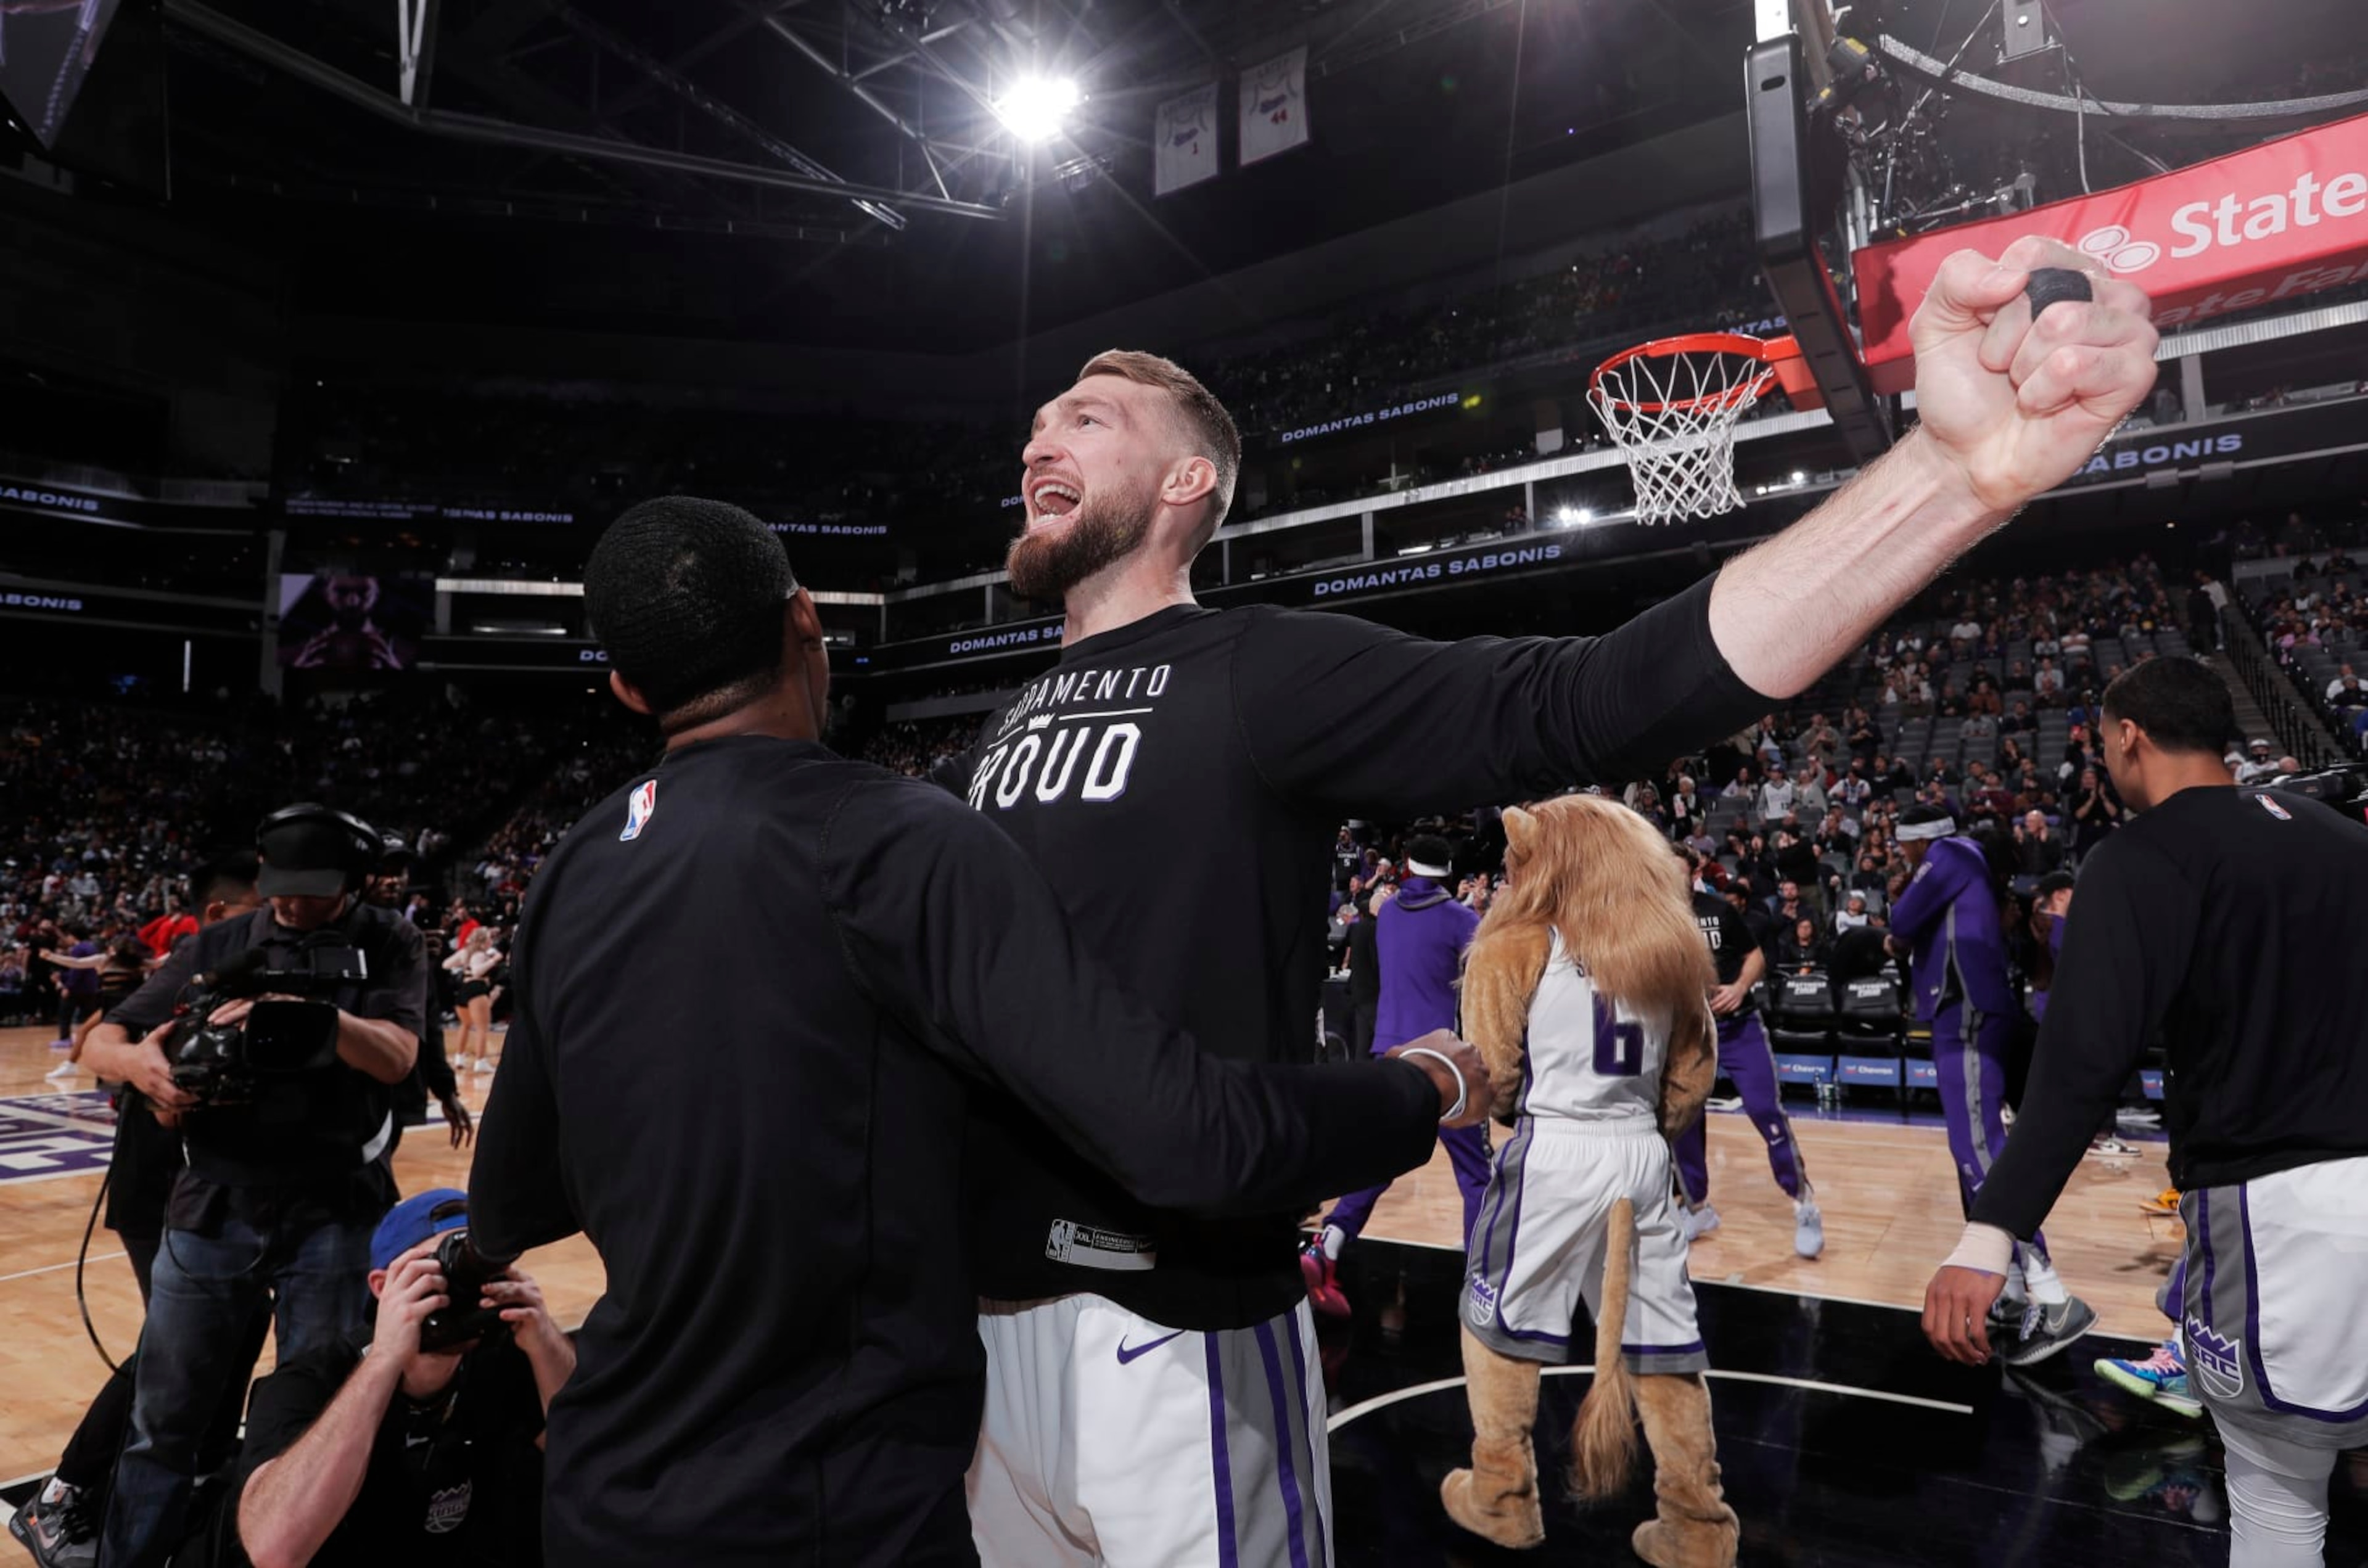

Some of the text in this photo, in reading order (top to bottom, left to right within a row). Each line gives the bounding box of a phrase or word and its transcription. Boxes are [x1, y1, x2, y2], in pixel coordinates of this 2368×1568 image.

[2169, 171, 2368, 258] State
[2151, 259, 2368, 327] ate Fa
[1281, 392, 1459, 443] DOMANTAS SABONIS
[2073, 433, 2243, 476] ABONIS
[0, 485, 100, 512] ABONIS
[499, 510, 574, 523] SABONIS
[767, 522, 888, 535] ANTAS SABONIS
[1314, 544, 1563, 596] DOMANTAS SABONIS
[0, 592, 84, 611] BONIS
[949, 628, 1039, 654] DOMANTAS
